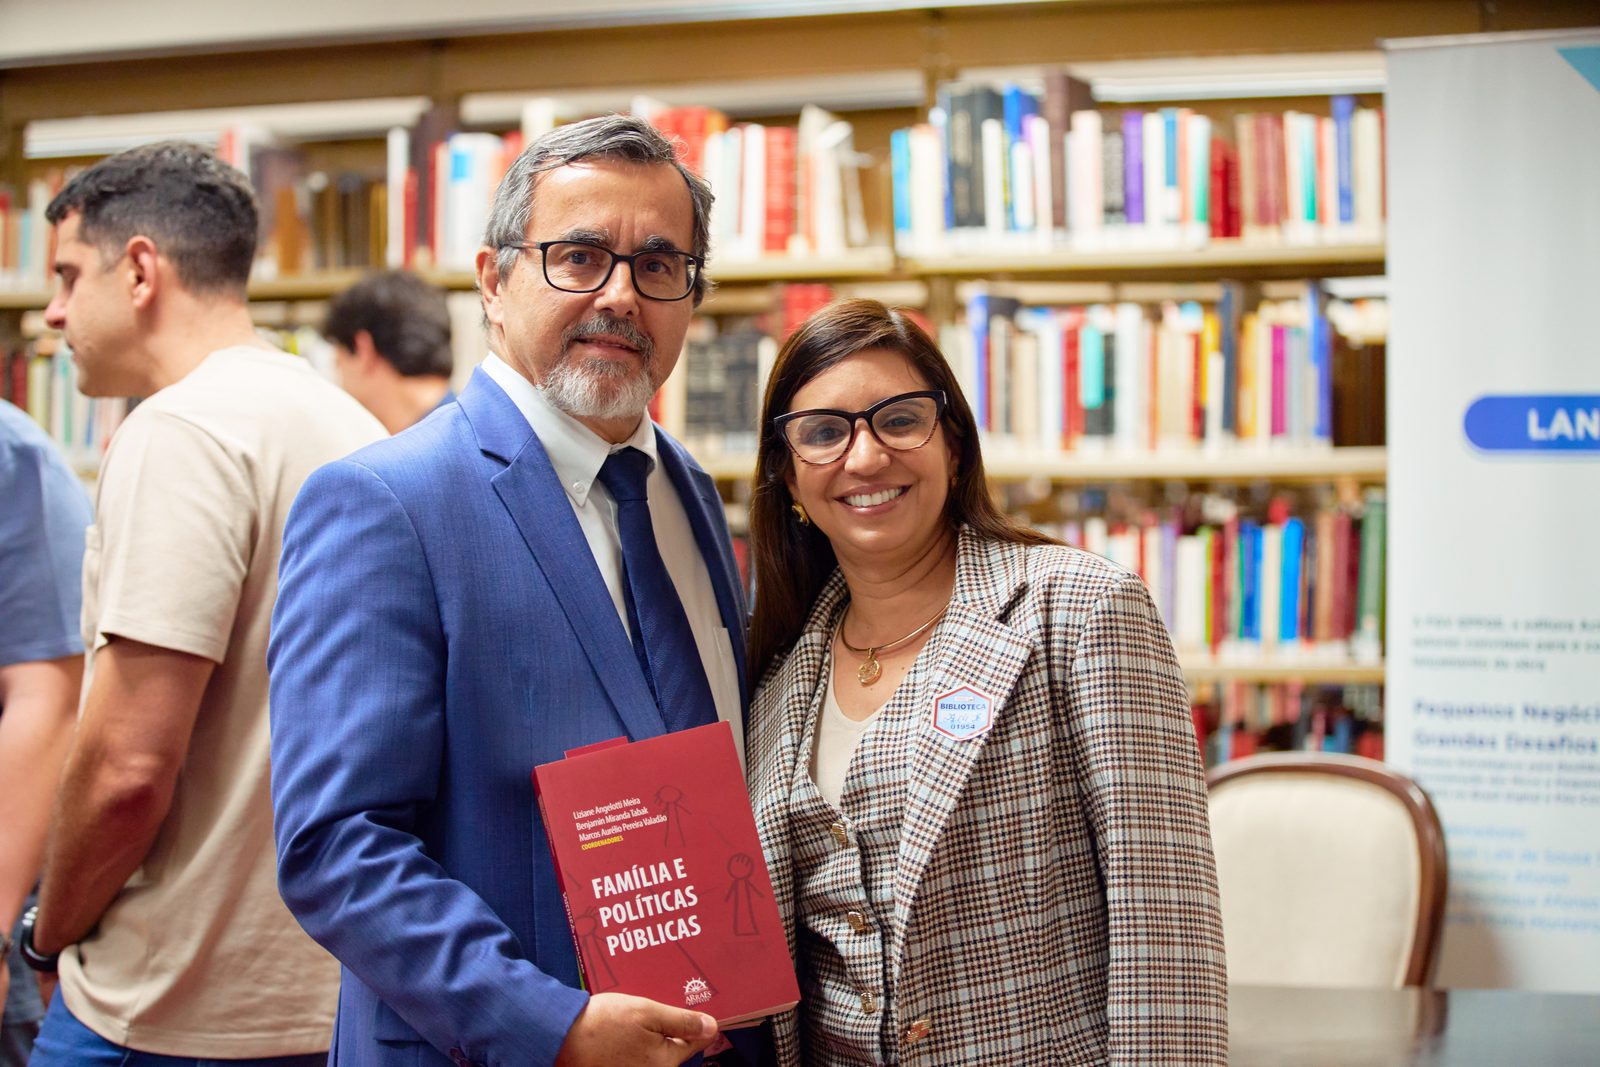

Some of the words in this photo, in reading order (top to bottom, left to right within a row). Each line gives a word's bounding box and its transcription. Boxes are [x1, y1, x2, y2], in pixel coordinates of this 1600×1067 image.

[1526, 407, 1600, 441] LAN
[573, 809, 595, 819] Liziane
[595, 801, 622, 814] Angelotti
[622, 797, 641, 808] Meira
[576, 818, 606, 831] Benjamin
[606, 811, 630, 824] Miranda
[630, 806, 648, 818] Tabak
[578, 830, 601, 842] Marcos
[601, 825, 622, 836] Aurélio
[622, 820, 644, 831] Pereira
[642, 814, 668, 826] Valadão
[581, 835, 624, 850] COORDENADORES
[592, 864, 672, 899] FAMÍLIA
[673, 858, 687, 879] E
[599, 885, 698, 928] POLÍTICAS
[606, 914, 702, 956] PÚBLICAS
